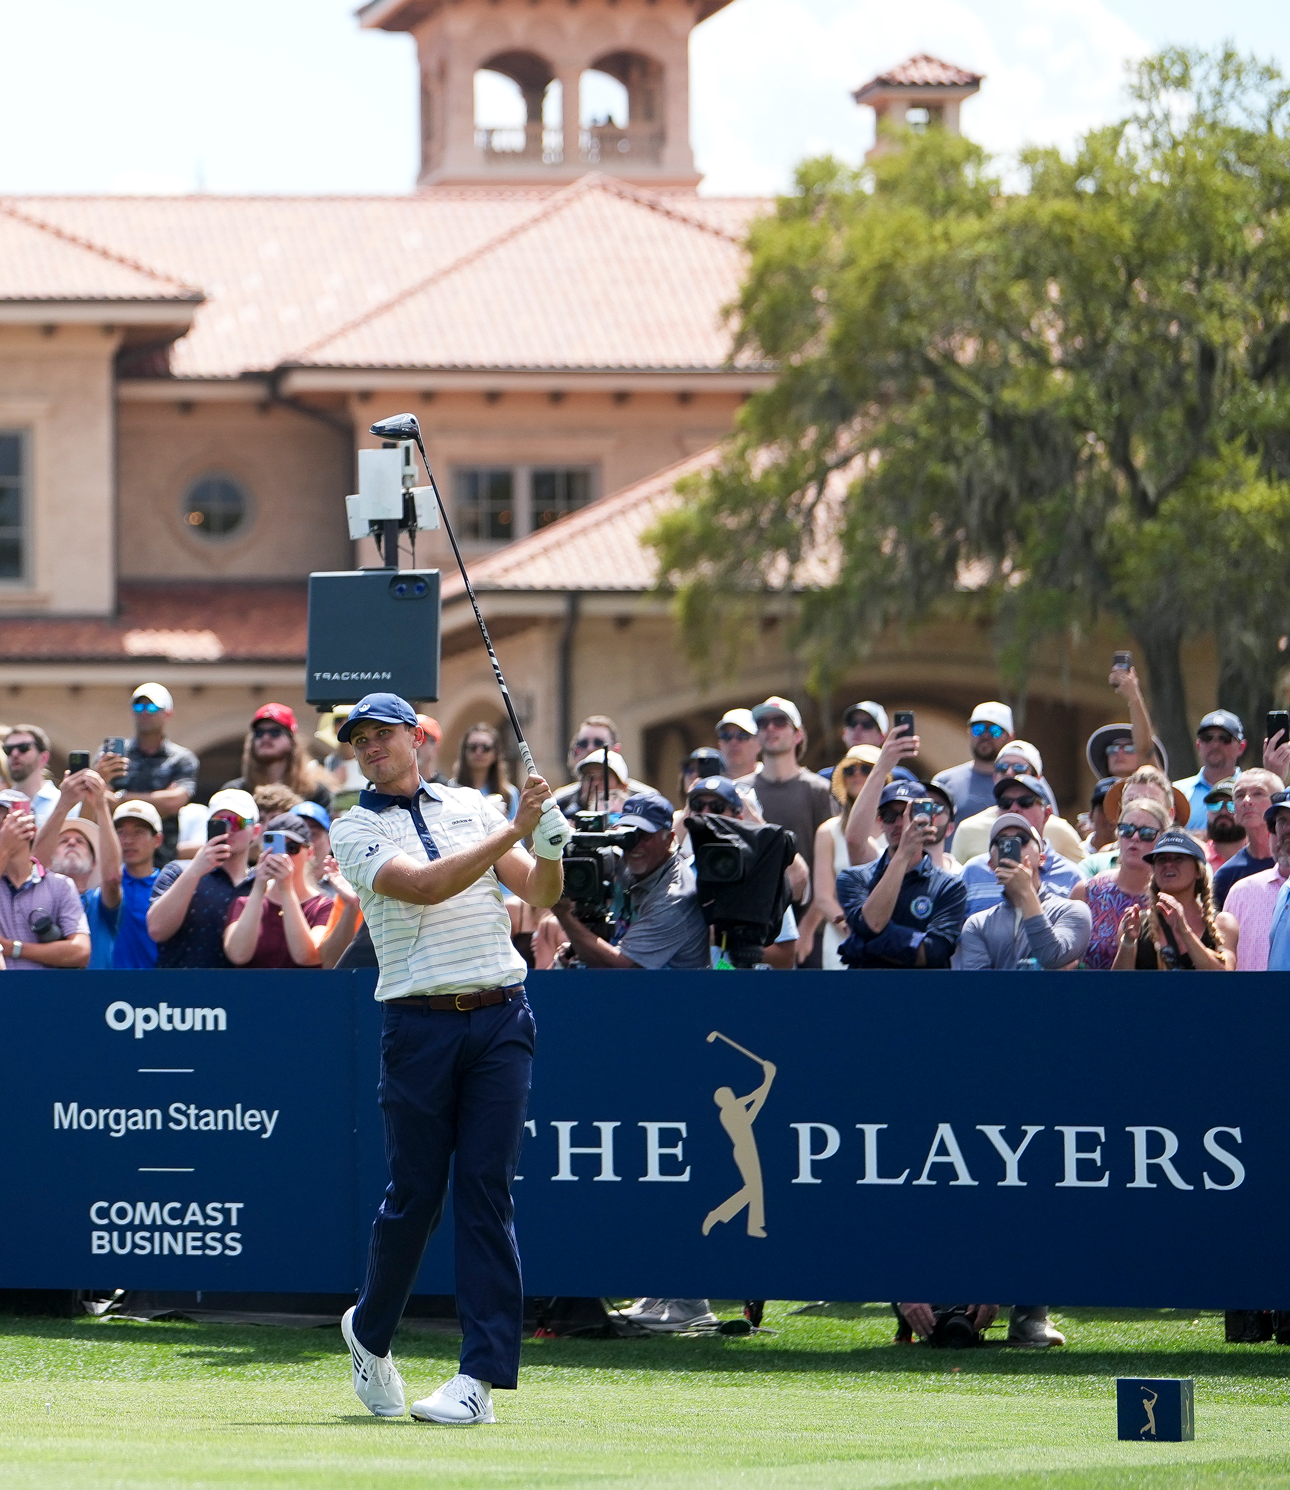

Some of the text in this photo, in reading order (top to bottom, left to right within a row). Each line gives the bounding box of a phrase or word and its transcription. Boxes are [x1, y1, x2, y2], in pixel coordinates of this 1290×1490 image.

[313, 671, 392, 681] TRACKMAN
[105, 1000, 227, 1039] Optum
[53, 1102, 280, 1139] Morgan Stanley
[789, 1122, 1246, 1191] PLAYERS
[89, 1201, 244, 1226] COMCAST
[91, 1231, 243, 1256] BUSINESS
